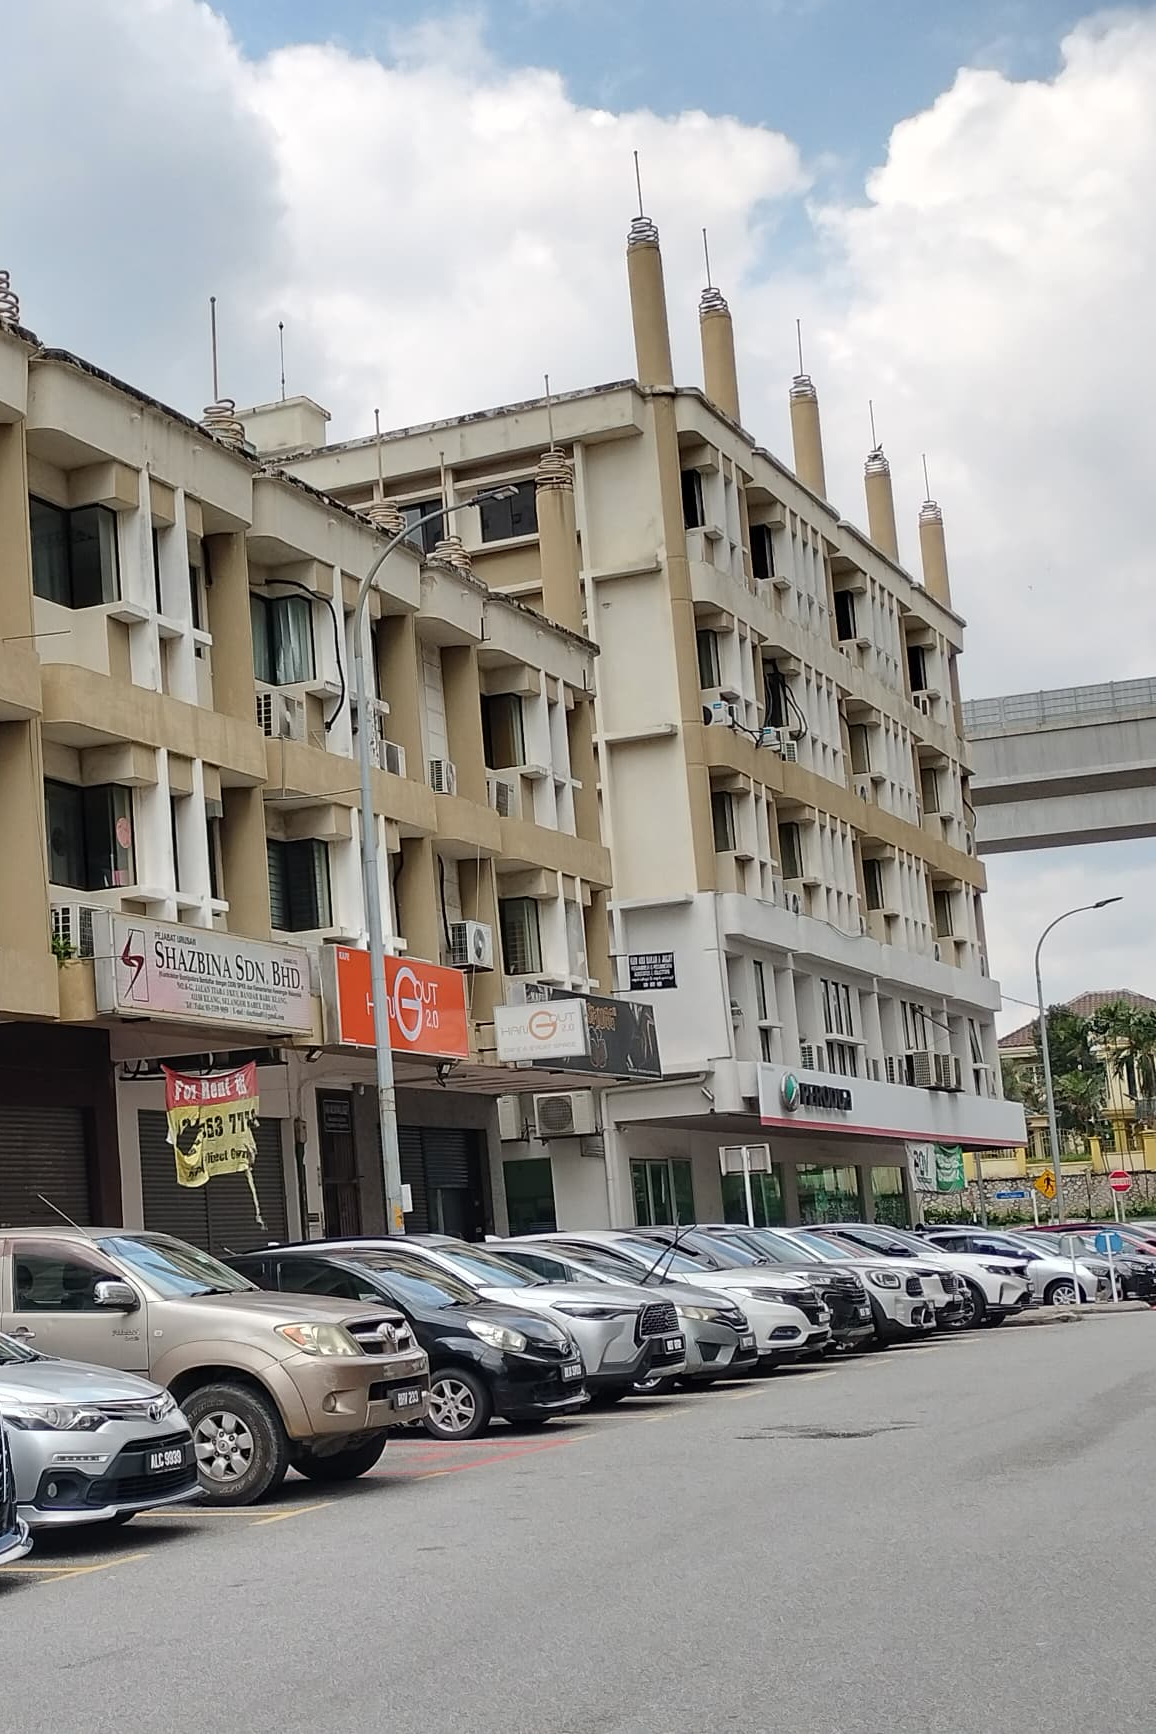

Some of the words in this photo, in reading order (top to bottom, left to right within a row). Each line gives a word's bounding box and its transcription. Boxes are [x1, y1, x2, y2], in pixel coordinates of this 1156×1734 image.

[154, 931, 176, 942] PEJABAT
[155, 940, 233, 979] SHAZBINA
[235, 954, 269, 985] SDN.
[273, 961, 304, 991] BHD.
[426, 1009, 439, 1029] 2.0
[174, 1080, 196, 1101] For
[201, 1077, 231, 1100] Rent
